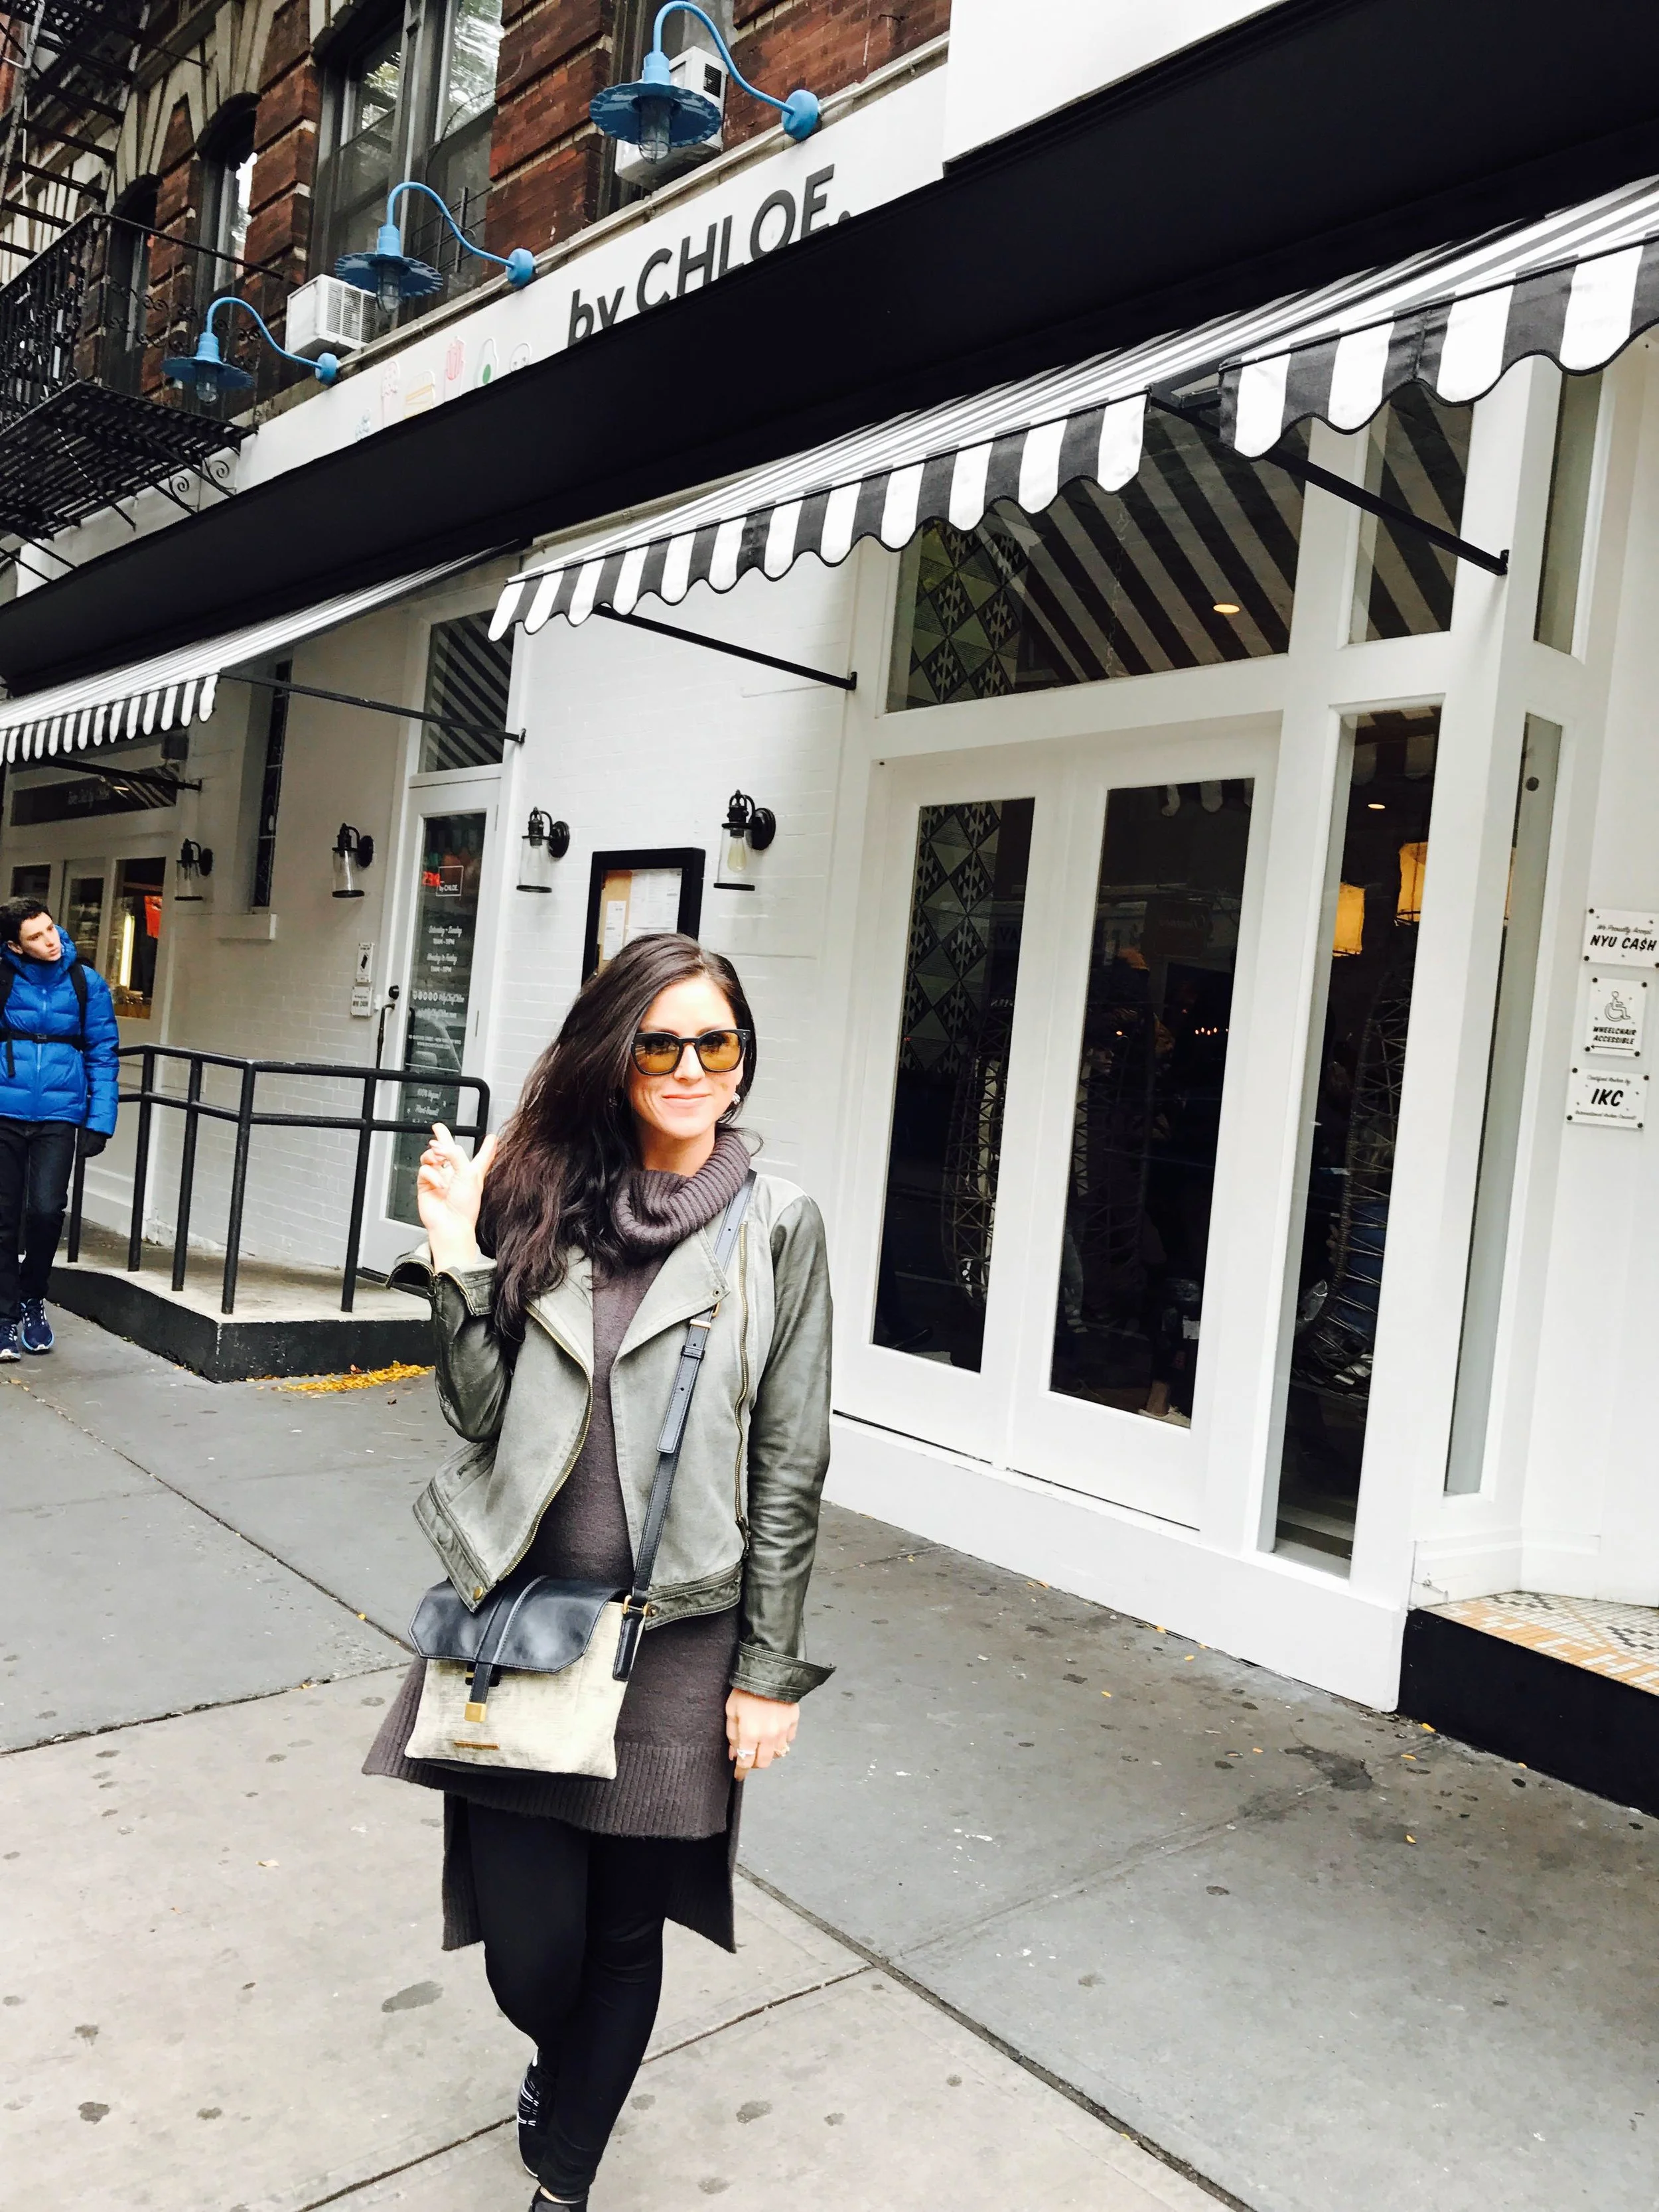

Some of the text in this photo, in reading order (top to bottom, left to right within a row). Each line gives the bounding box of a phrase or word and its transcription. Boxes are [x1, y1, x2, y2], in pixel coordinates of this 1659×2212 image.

[1589, 934, 1618, 948] NYU
[1593, 1026, 1637, 1035] WHEELCHAIR
[1593, 1035, 1635, 1045] ACCESSIBLE
[1591, 1088, 1624, 1107] IKC
